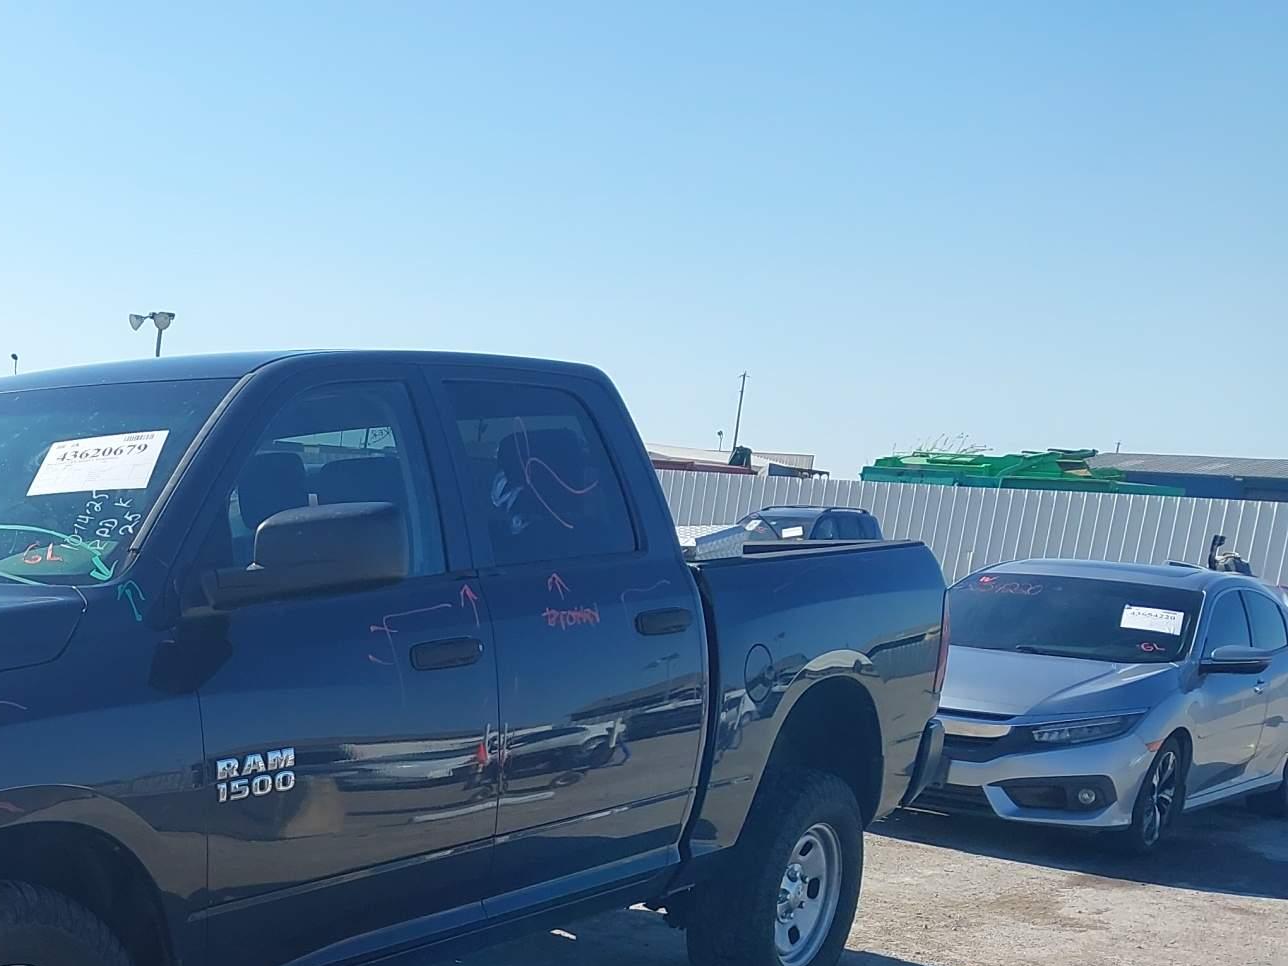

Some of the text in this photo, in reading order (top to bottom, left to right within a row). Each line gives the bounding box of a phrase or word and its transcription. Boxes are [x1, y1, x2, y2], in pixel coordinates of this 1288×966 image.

[56, 443, 148, 462] 43620679
[216, 747, 295, 780] RAM
[216, 769, 295, 803] 1500
